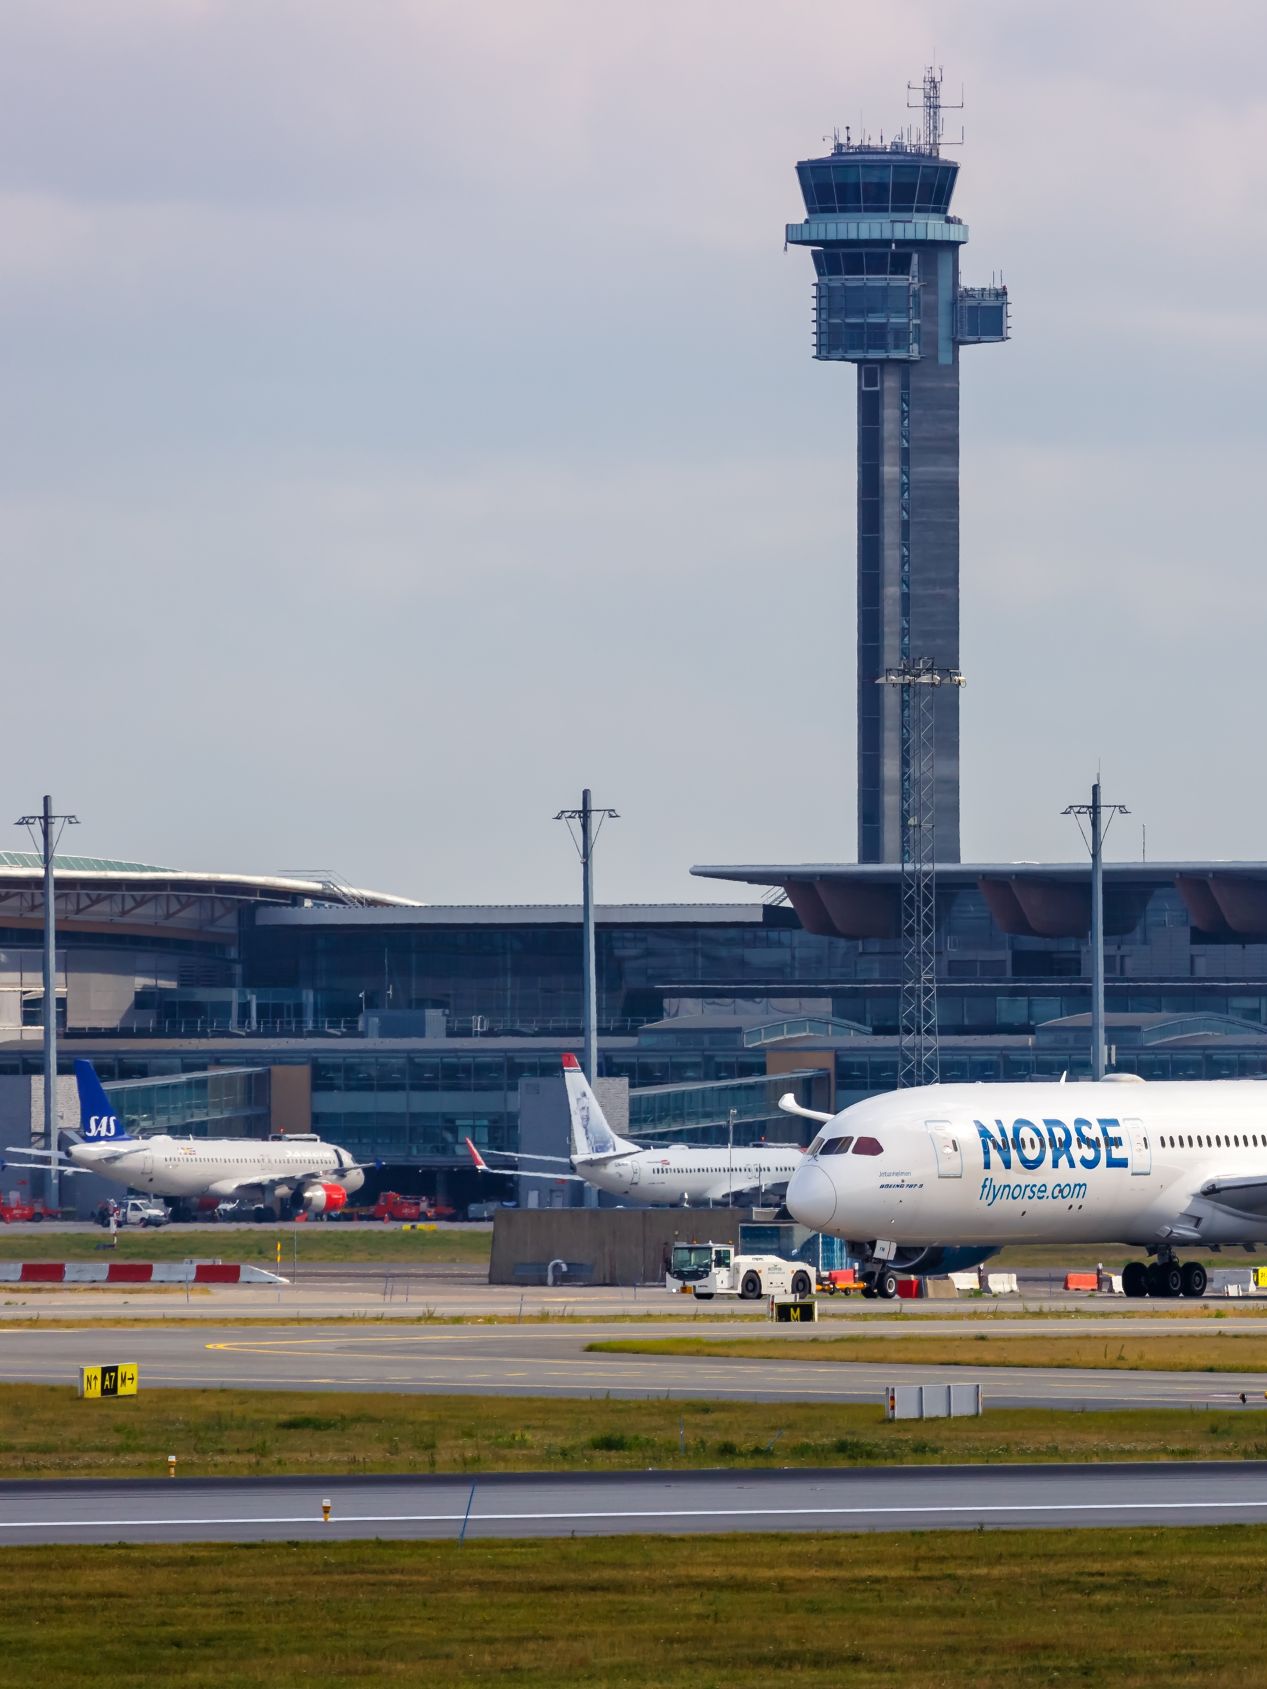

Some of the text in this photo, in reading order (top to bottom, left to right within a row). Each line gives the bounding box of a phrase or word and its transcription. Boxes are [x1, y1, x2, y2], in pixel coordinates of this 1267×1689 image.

[86, 1116, 116, 1137] SAS
[973, 1118, 1129, 1170] NORSE
[979, 1177, 1087, 1206] flynorse.com
[790, 1307, 801, 1322] M
[86, 1371, 127, 1391] N A7 M
